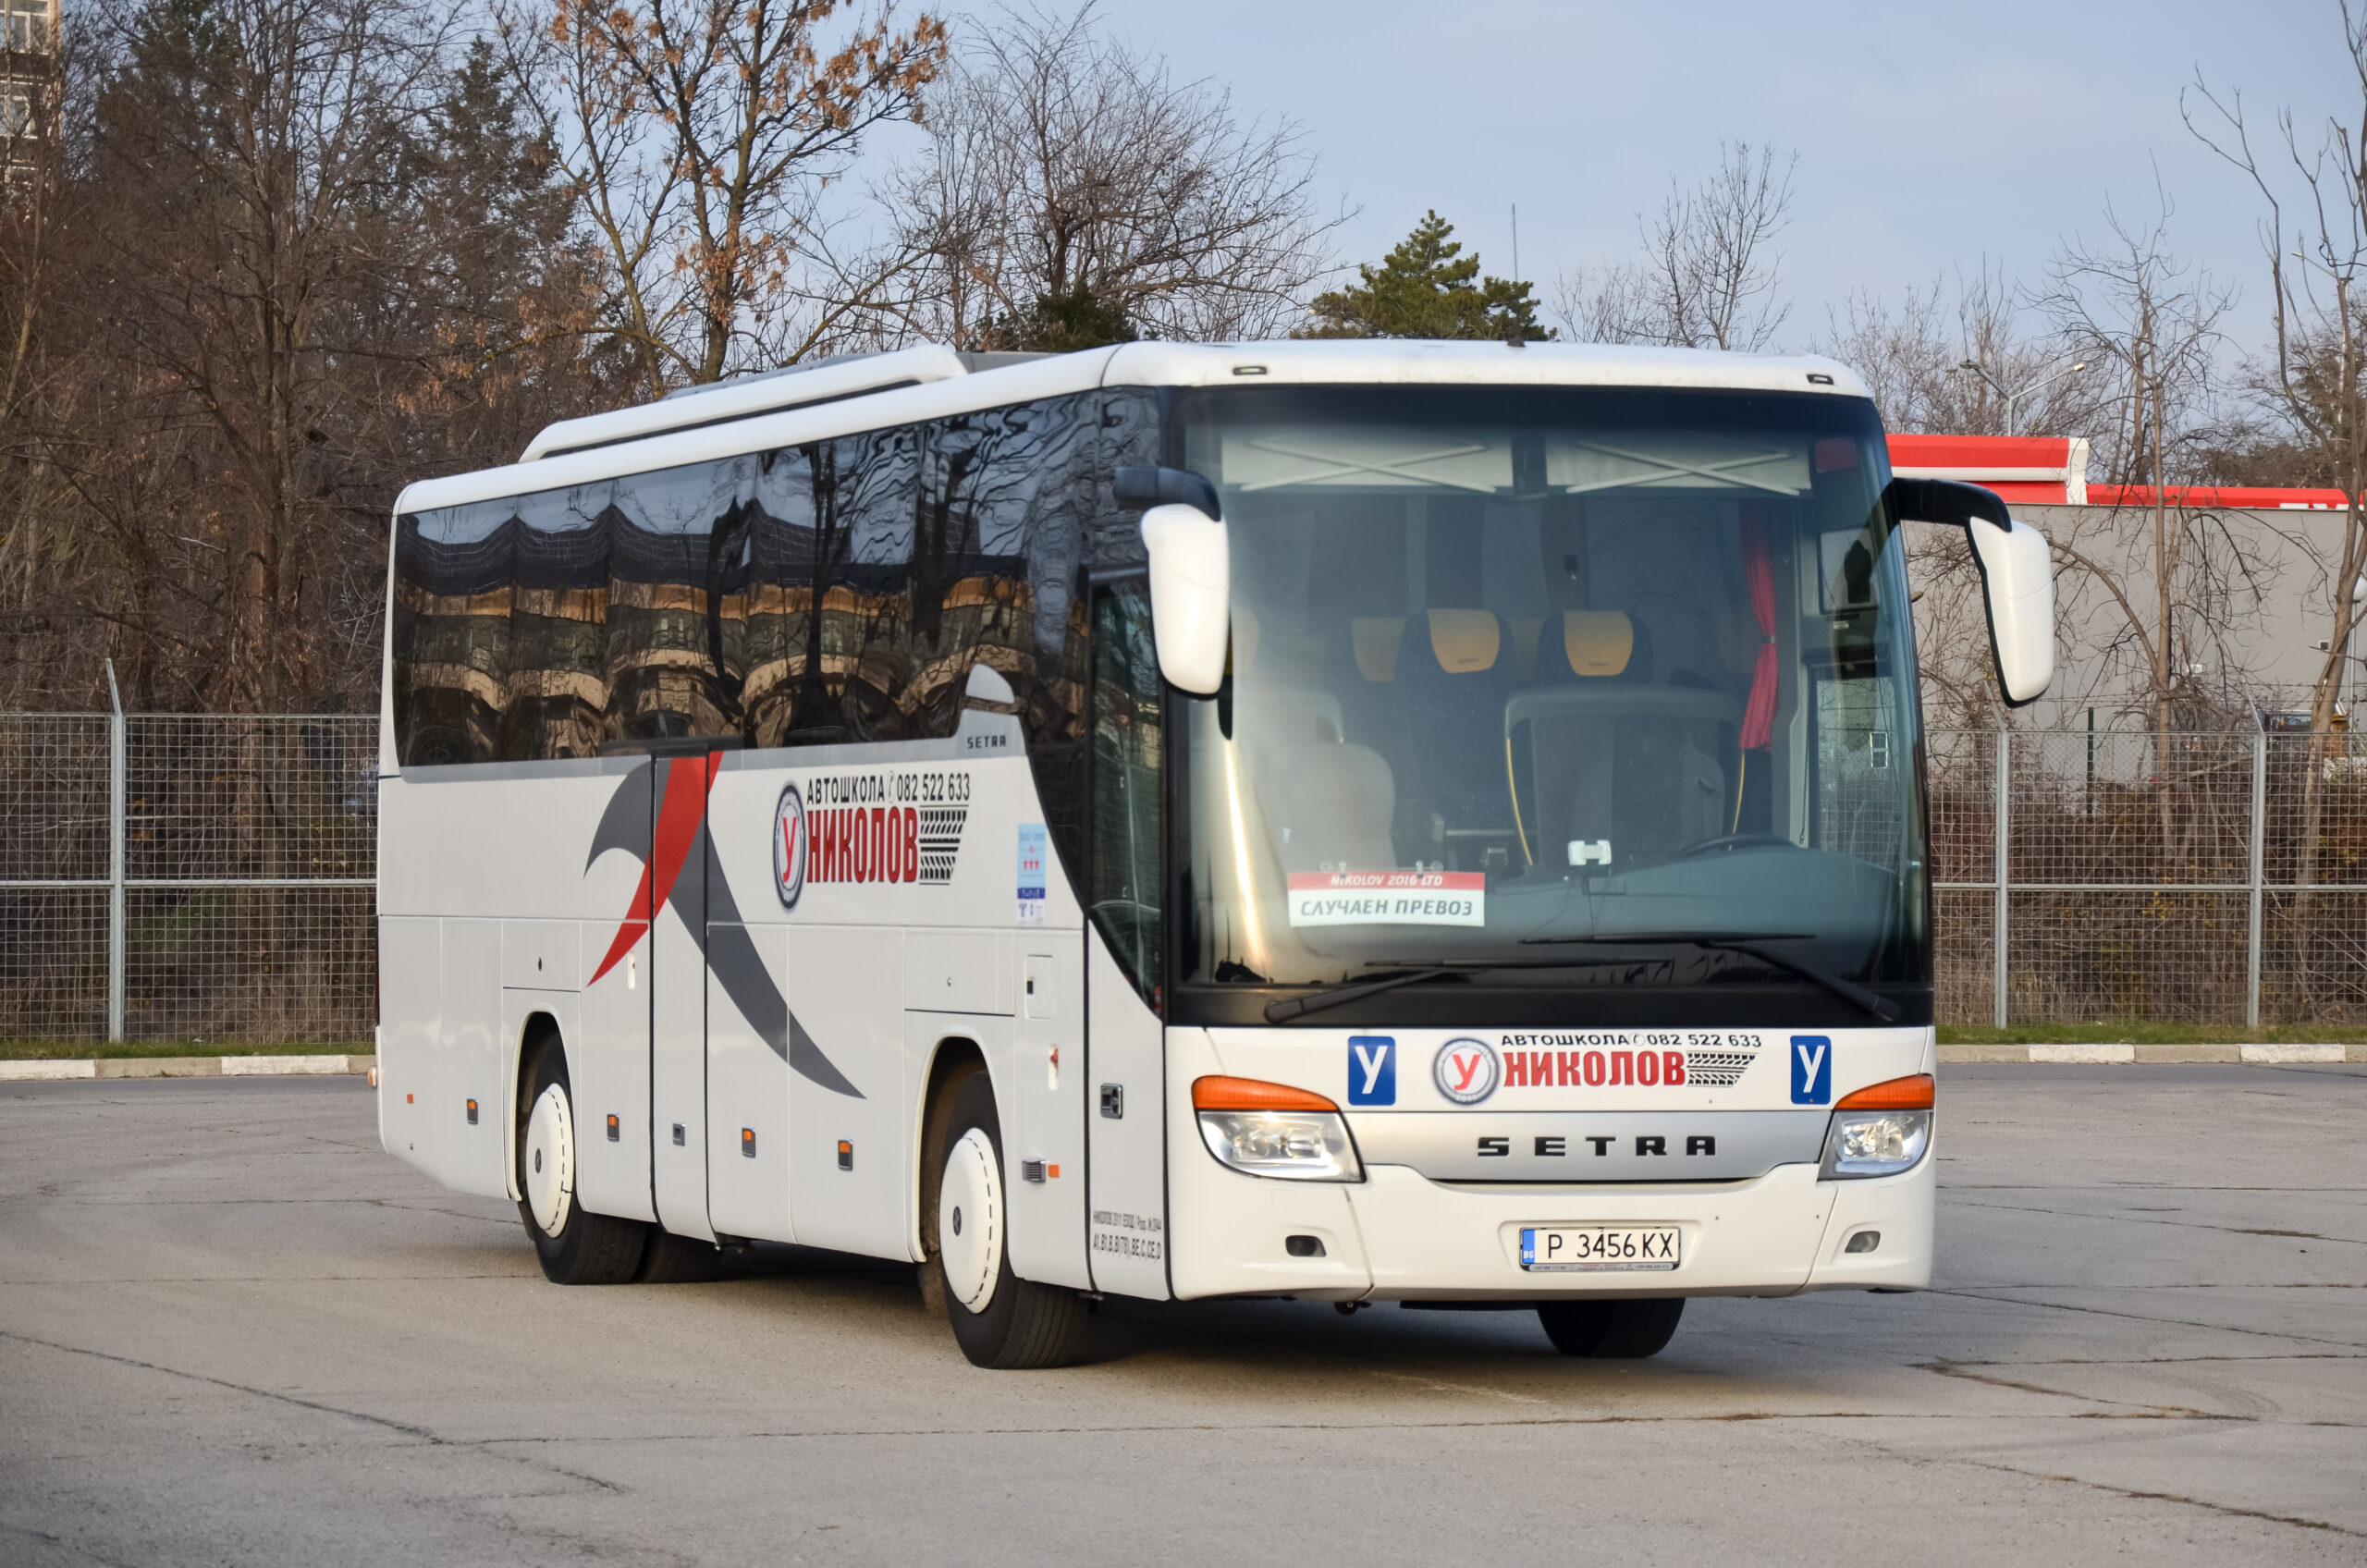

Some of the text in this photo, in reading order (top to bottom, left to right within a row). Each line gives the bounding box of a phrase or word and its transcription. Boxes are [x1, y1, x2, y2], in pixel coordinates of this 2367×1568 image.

[967, 735, 1007, 749] SETRA
[806, 772, 970, 805] АВТОШКОЛА 082 522 633
[806, 806, 918, 884] НИКОЛОВ
[1331, 874, 1444, 887] NIKOLOV 2016 LTD
[1300, 899, 1473, 916] СЛУЧАЕН ПРЕВОЗ
[1501, 1034, 1762, 1048] АВТОШКОЛА 082 522 633
[1502, 1050, 1686, 1087] НИКОЛОВ
[1477, 1135, 1717, 1158] SETRA
[1523, 1251, 1535, 1259] BG
[1548, 1232, 1674, 1259] P 3456 KX
